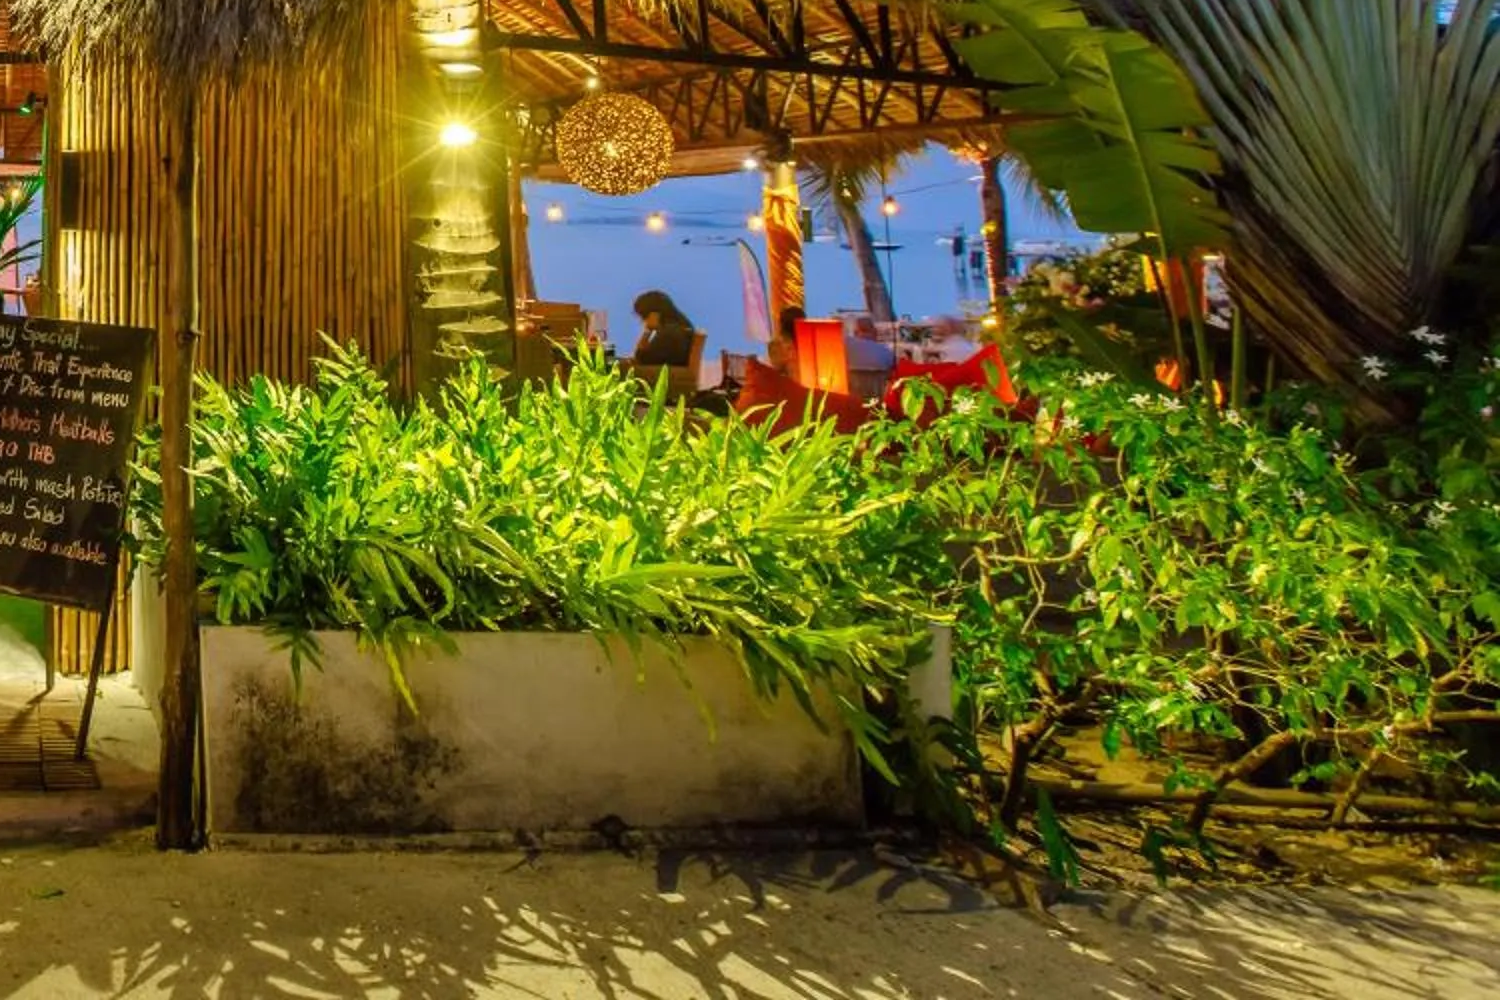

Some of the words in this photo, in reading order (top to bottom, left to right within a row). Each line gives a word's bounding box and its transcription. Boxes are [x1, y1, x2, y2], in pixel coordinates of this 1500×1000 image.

[31, 352, 62, 375] Thai
[49, 379, 85, 402] from
[27, 442, 56, 465] THB
[35, 474, 75, 500] mash
[23, 497, 66, 525] Salad
[20, 528, 47, 553] also
